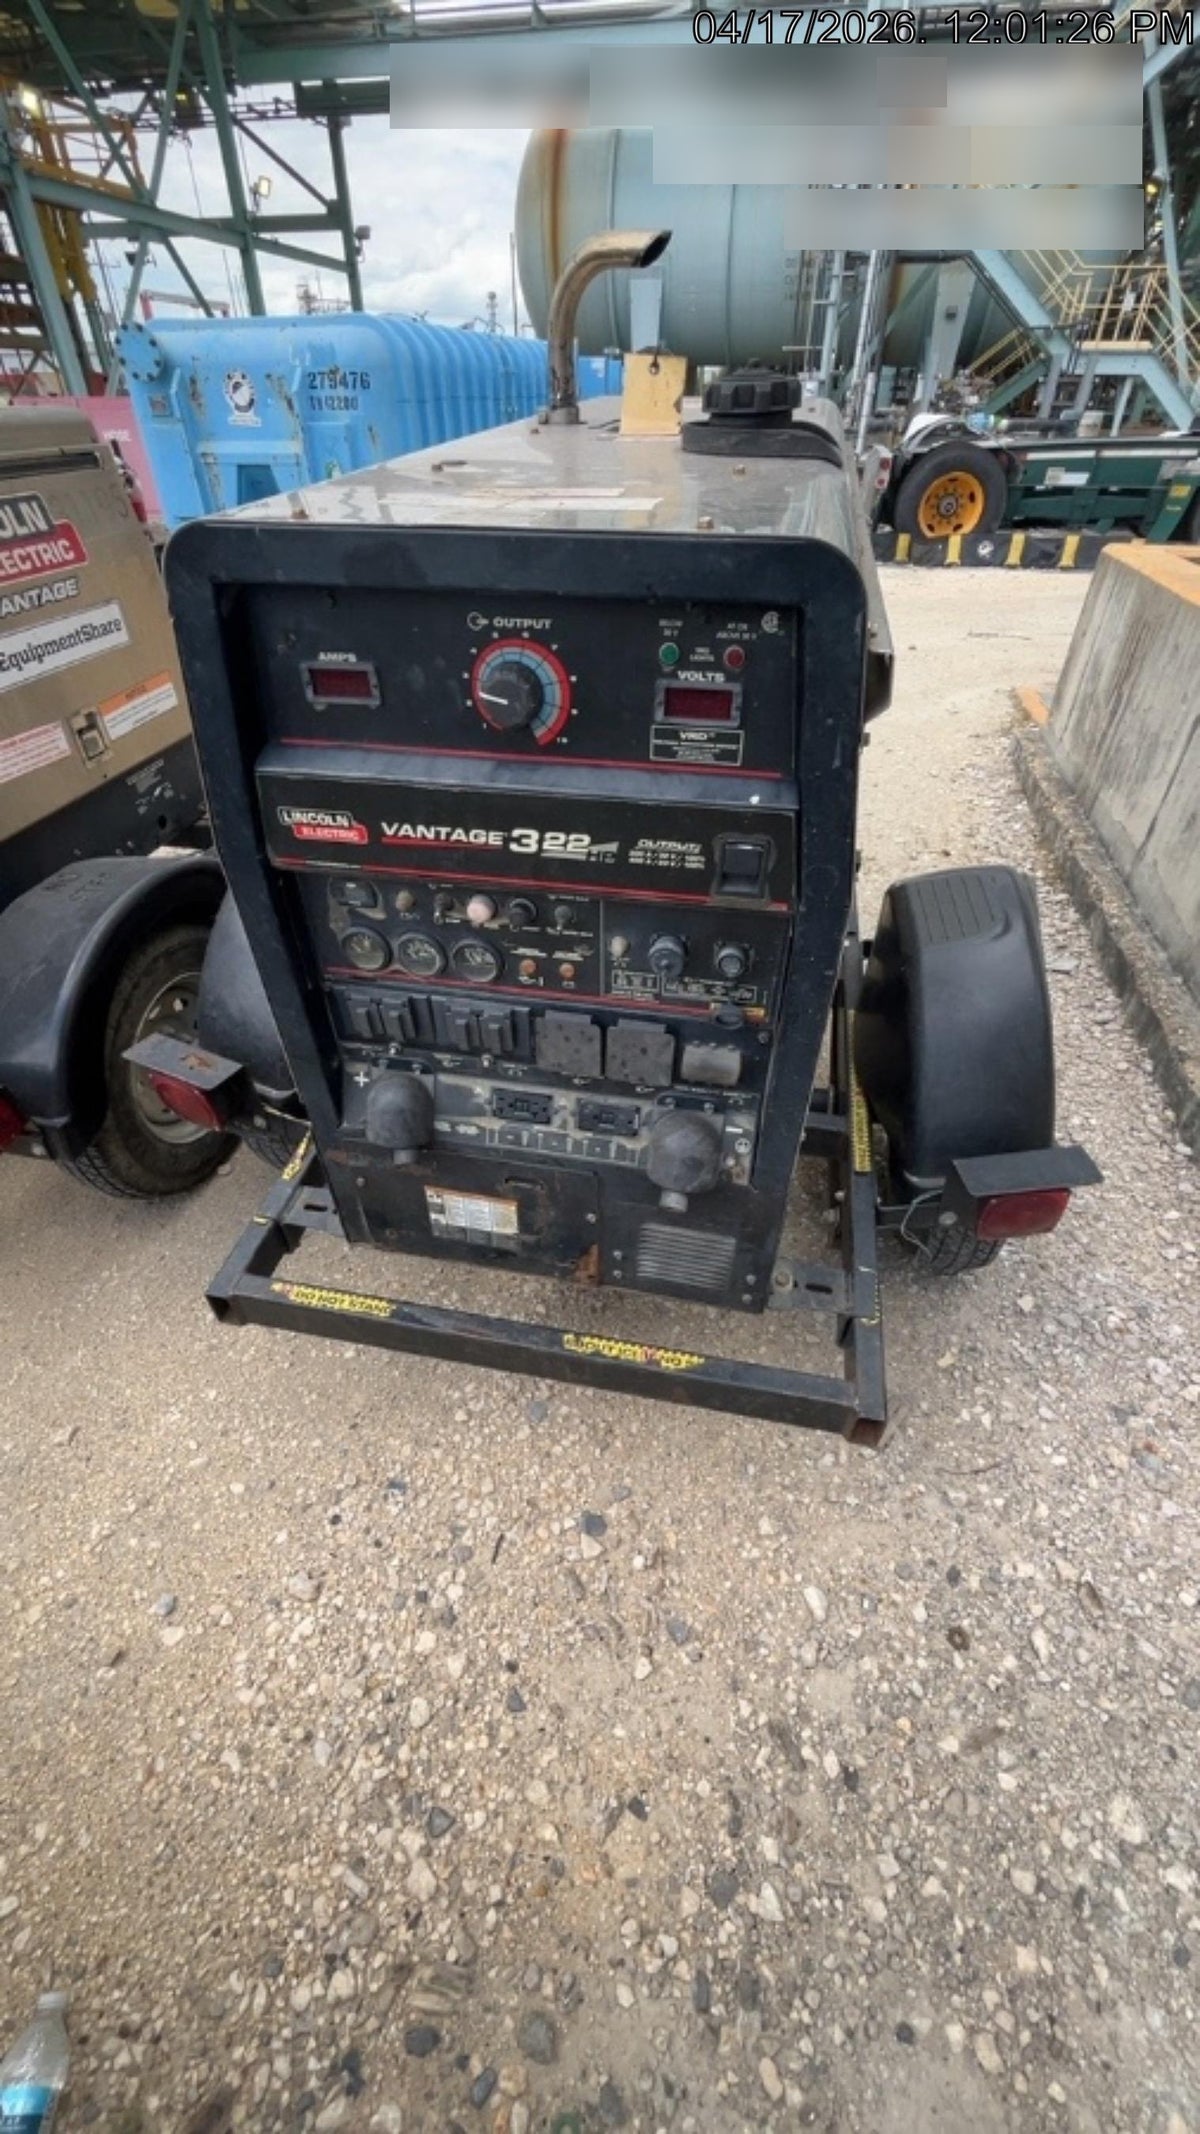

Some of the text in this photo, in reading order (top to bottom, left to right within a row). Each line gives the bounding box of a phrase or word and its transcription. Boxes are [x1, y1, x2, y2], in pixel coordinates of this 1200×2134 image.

[493, 617, 552, 629] OUTPUT
[0, 617, 122, 673] EquipmentShare
[318, 651, 357, 662] AMPS
[677, 670, 725, 683] VOLTS
[283, 810, 350, 828] LINCOLN
[301, 828, 360, 842] ELECTRIC
[381, 822, 592, 855] VANTAGE 322
